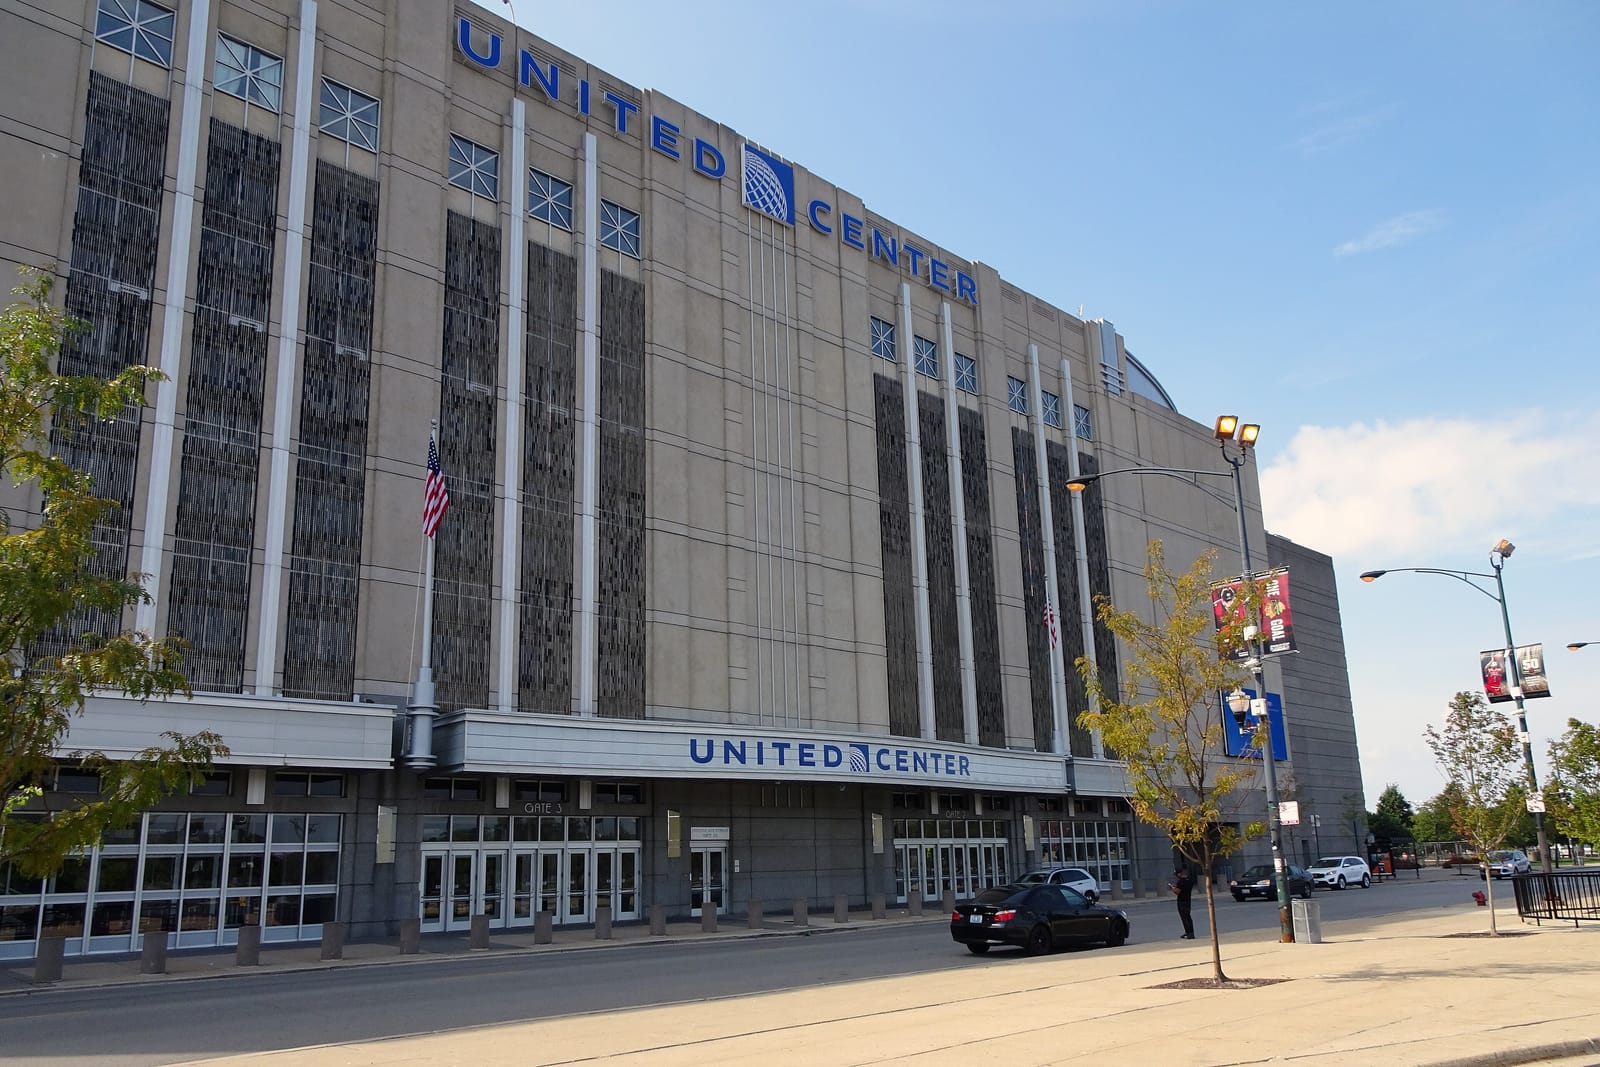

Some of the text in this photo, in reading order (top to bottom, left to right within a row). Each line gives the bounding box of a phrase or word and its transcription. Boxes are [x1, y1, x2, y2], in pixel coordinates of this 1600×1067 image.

[457, 16, 979, 305] UNITED CENTER
[1270, 618, 1286, 642] GOAL
[689, 738, 971, 776] UNITED CENTER
[524, 802, 562, 814] GATE 3
